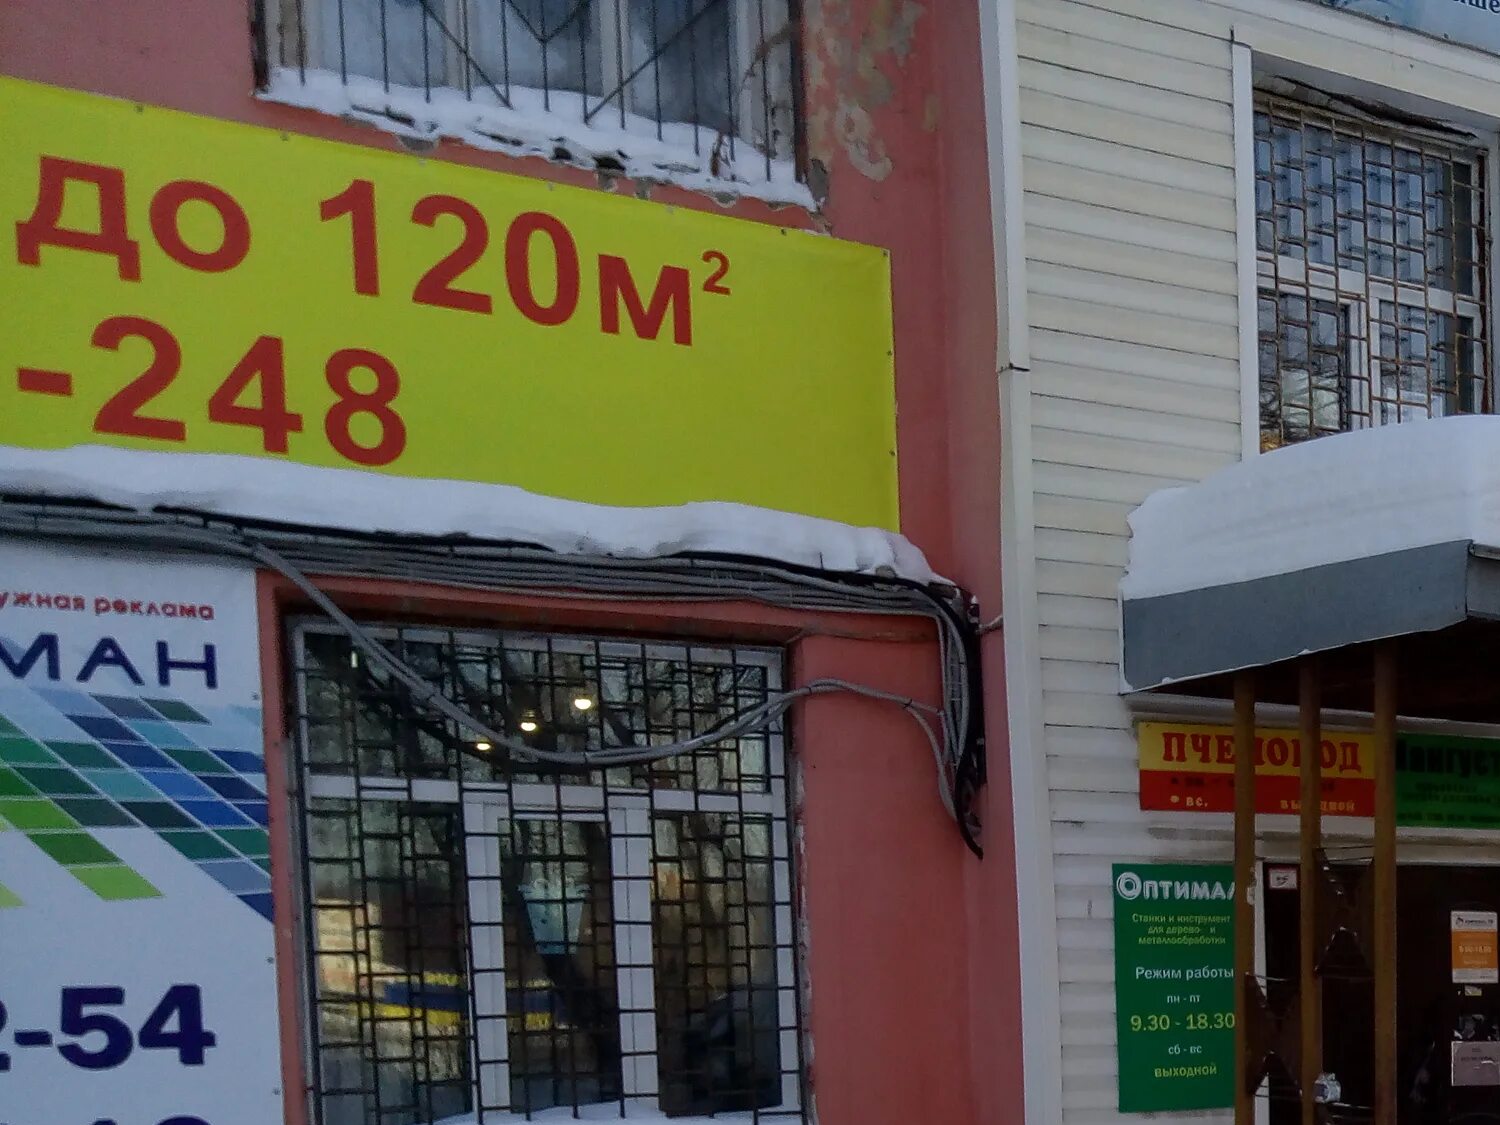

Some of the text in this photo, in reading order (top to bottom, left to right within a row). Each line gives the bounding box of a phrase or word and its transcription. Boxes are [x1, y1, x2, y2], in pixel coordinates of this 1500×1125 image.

[94, 597, 215, 621] реклама
[1162, 732, 1362, 773] ПЧЕООД
[1132, 913, 1166, 923] Станки
[1177, 914, 1231, 925] инструмент
[1135, 965, 1234, 981] Режим работы
[1167, 994, 1181, 1003] пн
[1189, 994, 1201, 1003] пт
[0, 983, 217, 1071] -54
[1130, 1015, 1170, 1031] 9.30
[1186, 1013, 1236, 1030] 18.30
[1168, 1043, 1181, 1054] сб
